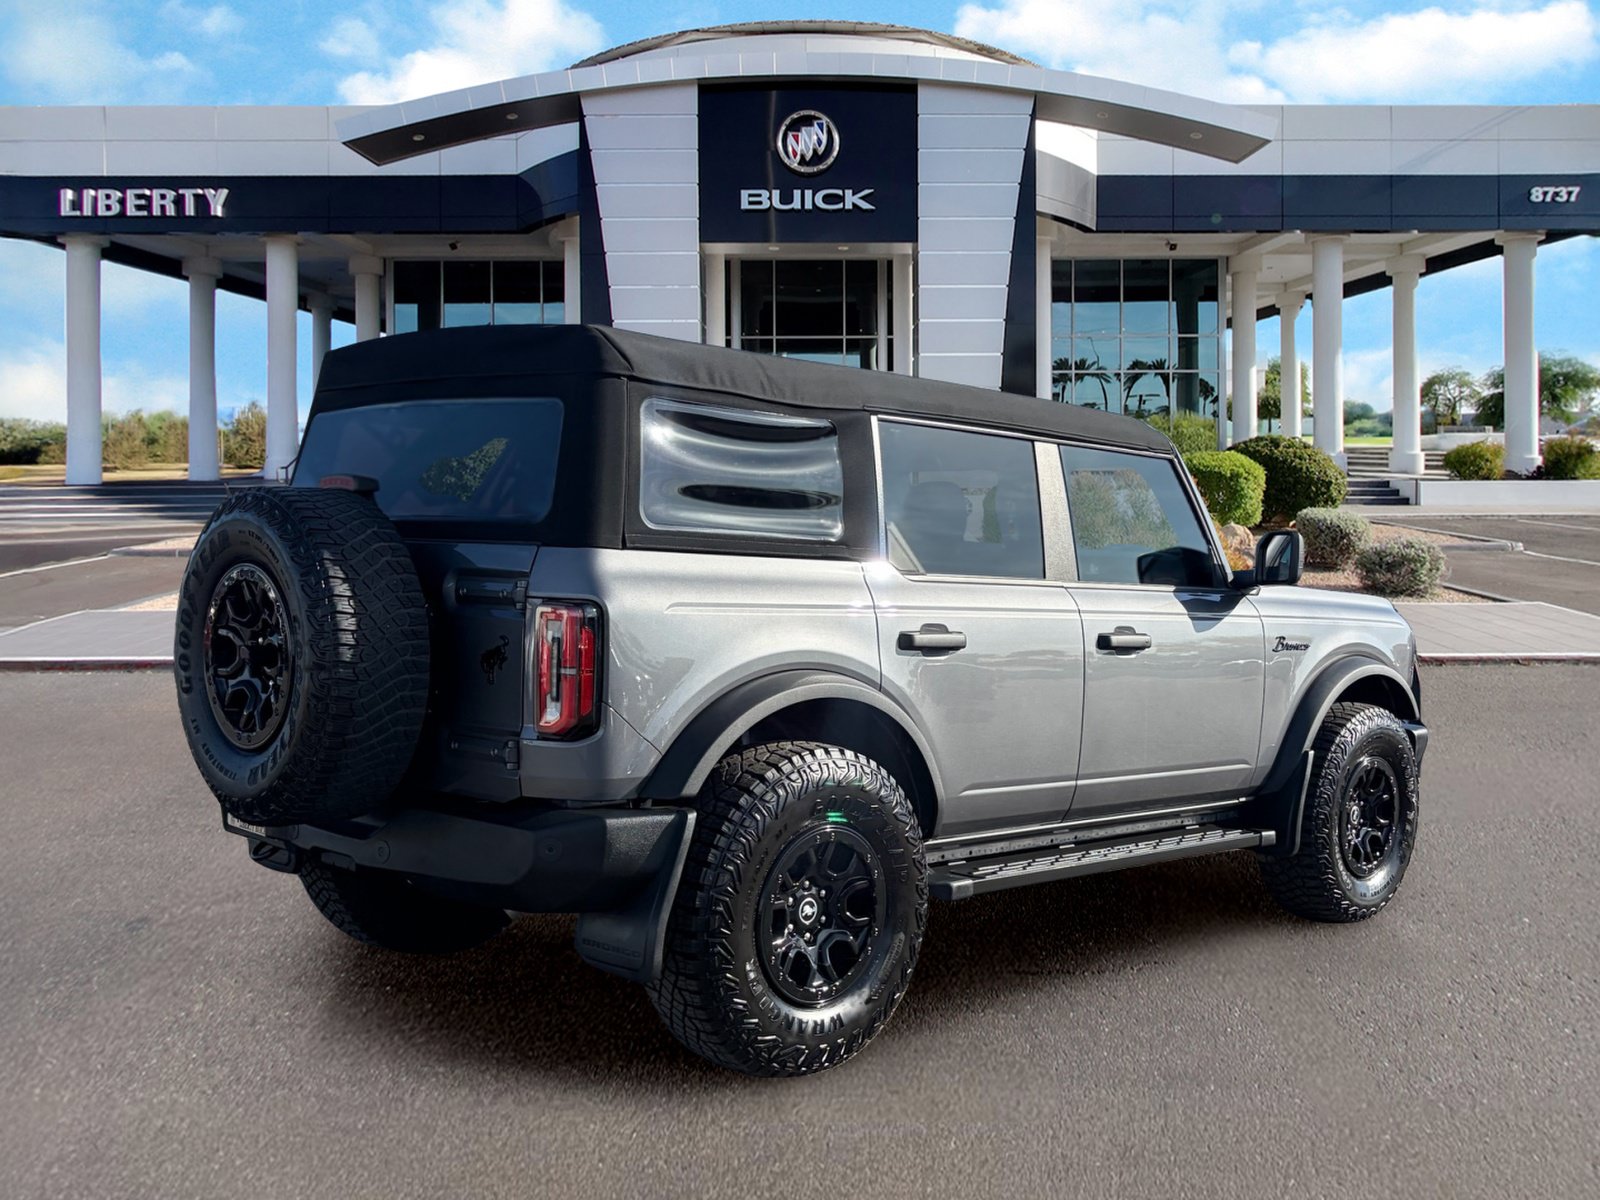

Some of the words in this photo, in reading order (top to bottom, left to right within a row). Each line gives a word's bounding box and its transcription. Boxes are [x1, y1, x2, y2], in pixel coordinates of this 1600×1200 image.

[59, 187, 229, 217] LIBERTY
[740, 188, 876, 210] BUICK
[1529, 186, 1581, 203] 8737
[178, 529, 231, 695] GOODYEAR
